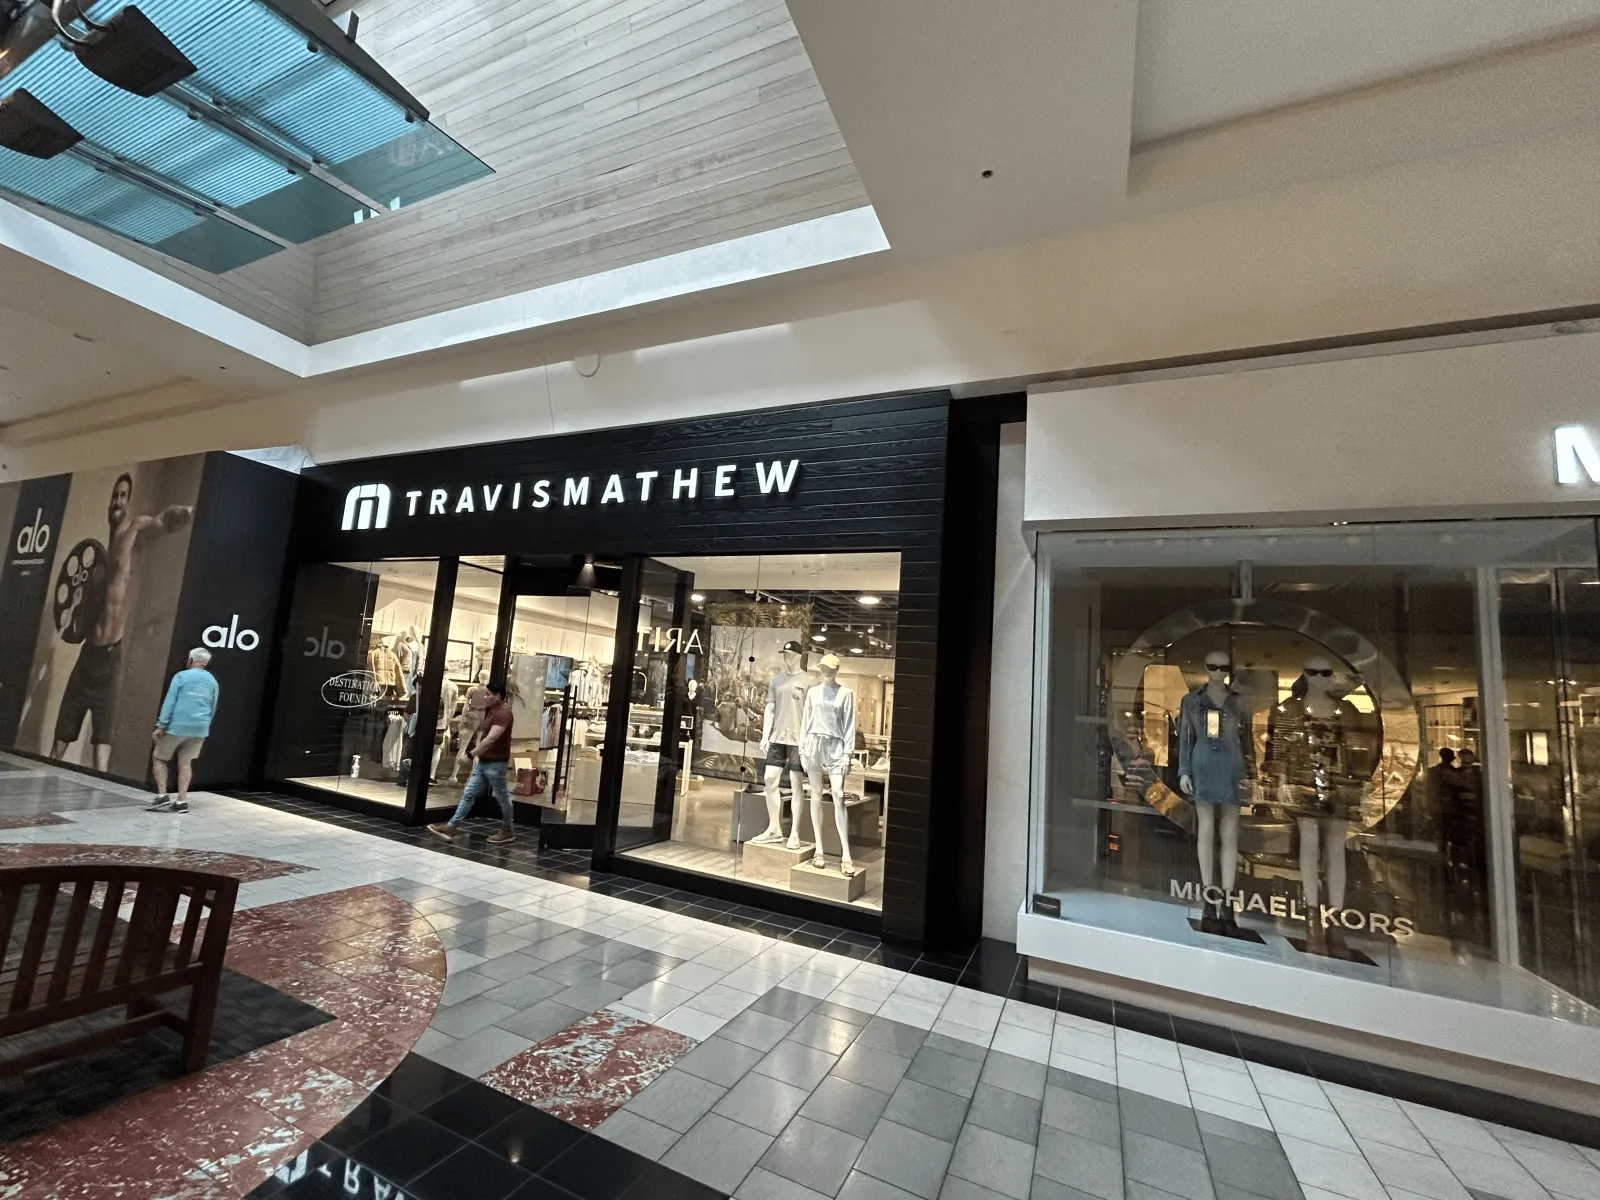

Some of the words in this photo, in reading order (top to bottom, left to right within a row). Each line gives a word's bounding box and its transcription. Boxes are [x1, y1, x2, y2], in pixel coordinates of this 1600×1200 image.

[406, 459, 799, 516] TRAVISMATHEW
[16, 507, 50, 554] alo
[201, 614, 259, 651] alo
[328, 676, 381, 692] DESTINATION
[338, 691, 368, 705] FOUND
[1169, 878, 1306, 921] MICHAEL
[1320, 904, 1415, 938] KORS
